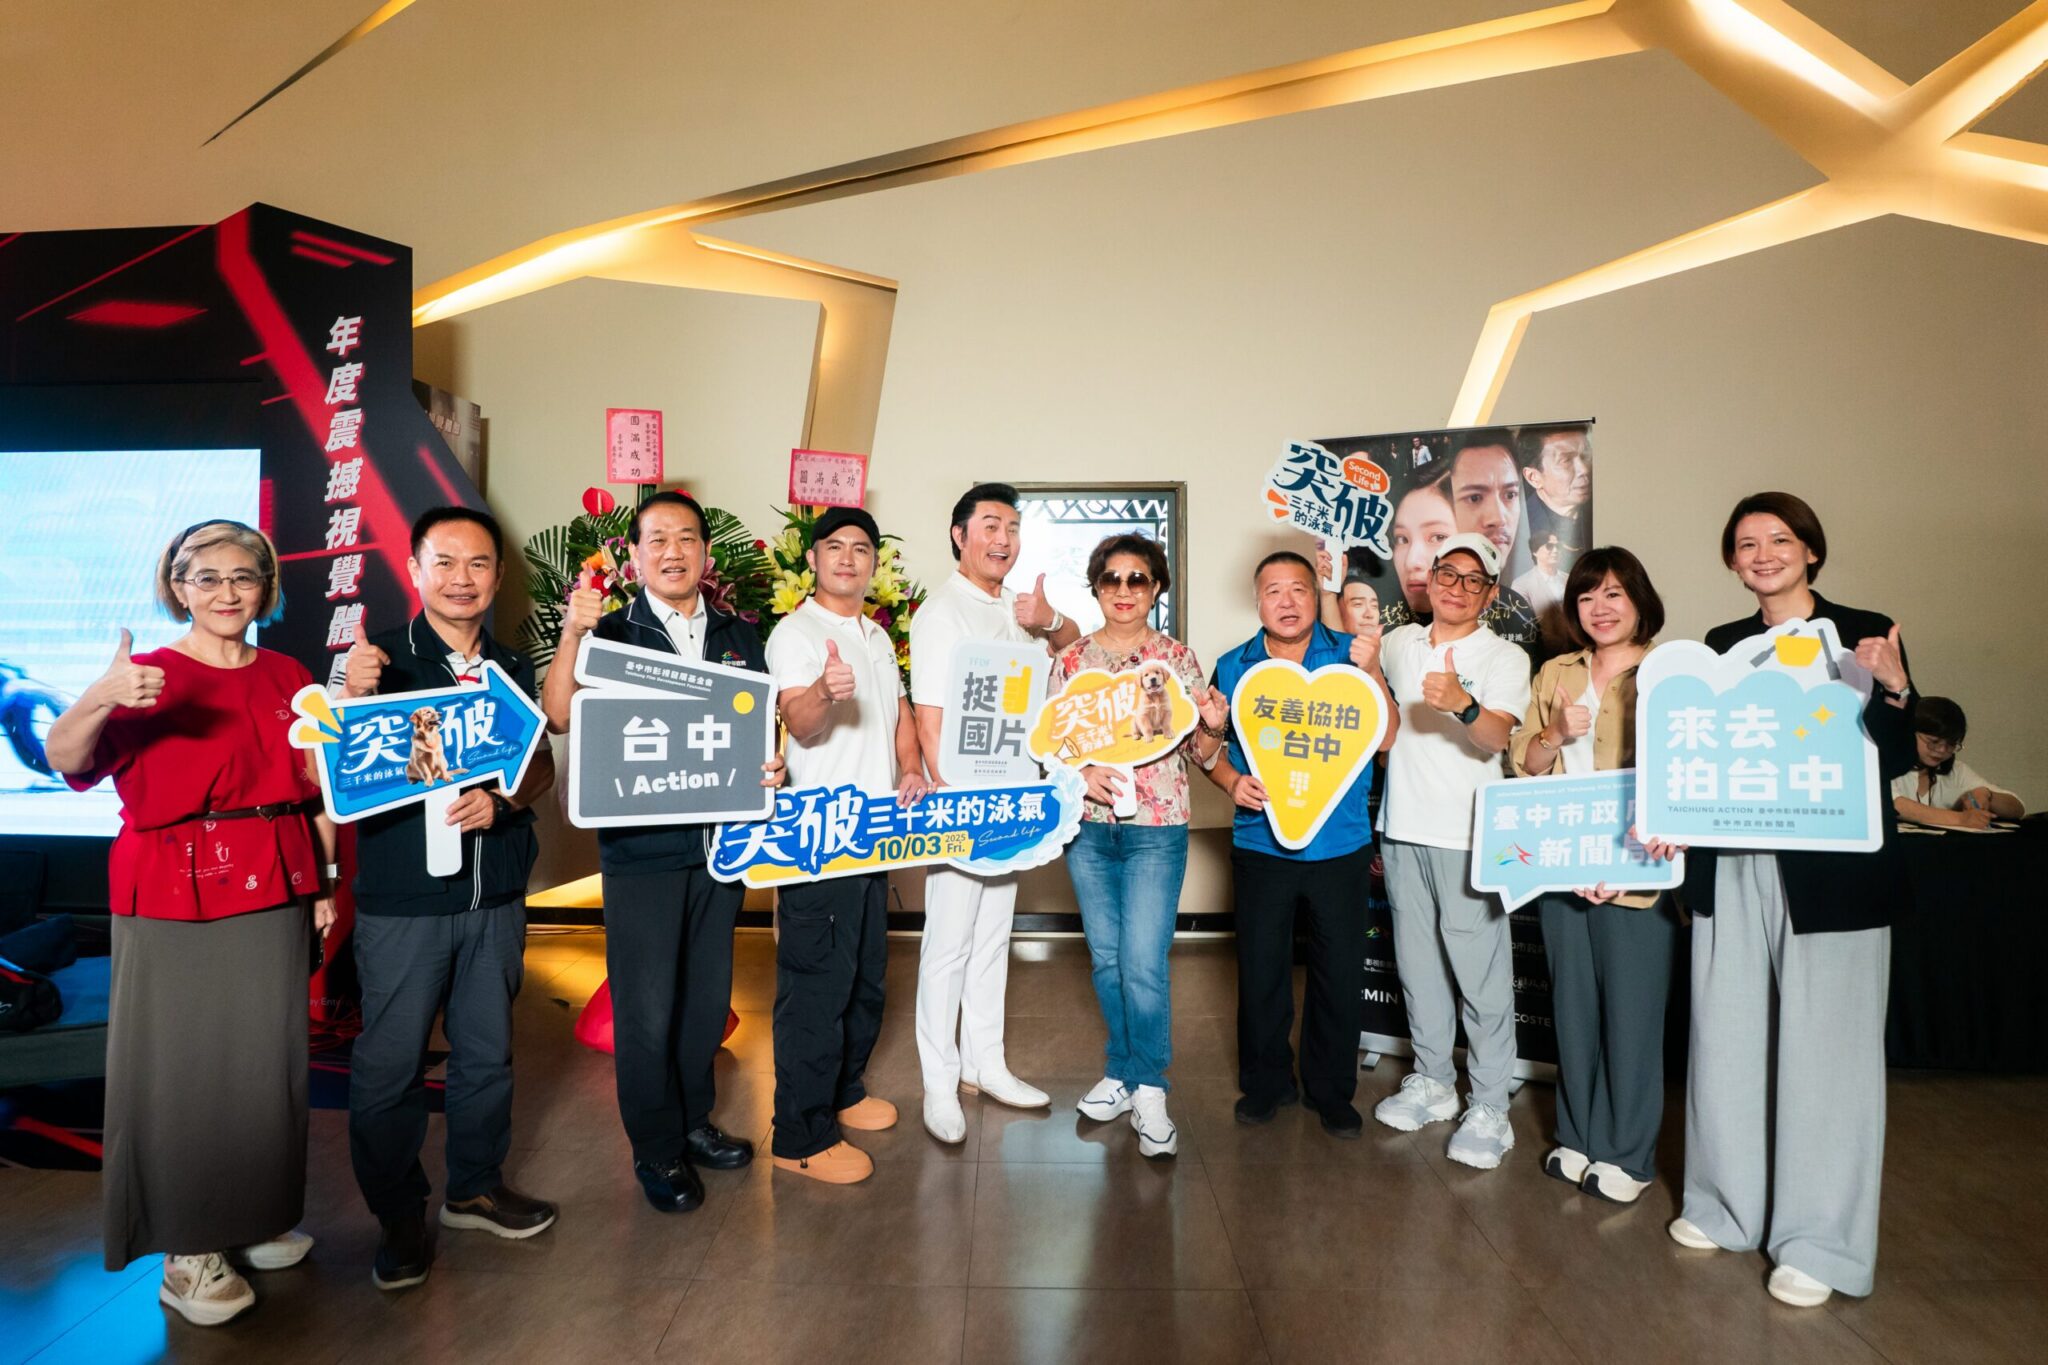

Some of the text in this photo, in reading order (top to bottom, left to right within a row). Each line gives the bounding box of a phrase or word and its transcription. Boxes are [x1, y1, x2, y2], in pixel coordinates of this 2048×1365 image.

[630, 415, 641, 477] 圓滿成功
[799, 469, 856, 487] 圓滿成功
[1348, 460, 1381, 481] Second
[1353, 474, 1370, 488] Life
[1272, 443, 1388, 554] 突破
[1289, 494, 1330, 521] 三千米
[1294, 510, 1334, 537] 的泳氣
[962, 671, 998, 713] 挺
[1052, 681, 1137, 739] 突破
[1253, 695, 1361, 730] 友善協拍
[1666, 703, 1781, 750] 來去
[340, 697, 506, 775] 突破
[622, 714, 731, 761] 台中
[958, 715, 1026, 757] 國片
[343, 766, 404, 786] 三千米的泳氣
[632, 770, 720, 795] Action
[1666, 755, 1843, 803] 拍台中
[722, 786, 869, 872] 突破
[867, 792, 1046, 835] 三千米的泳氣
[877, 837, 941, 861] 10/03
[945, 834, 966, 843] 2025
[946, 843, 965, 854] Fri.
[1362, 988, 1398, 1004] MIN
